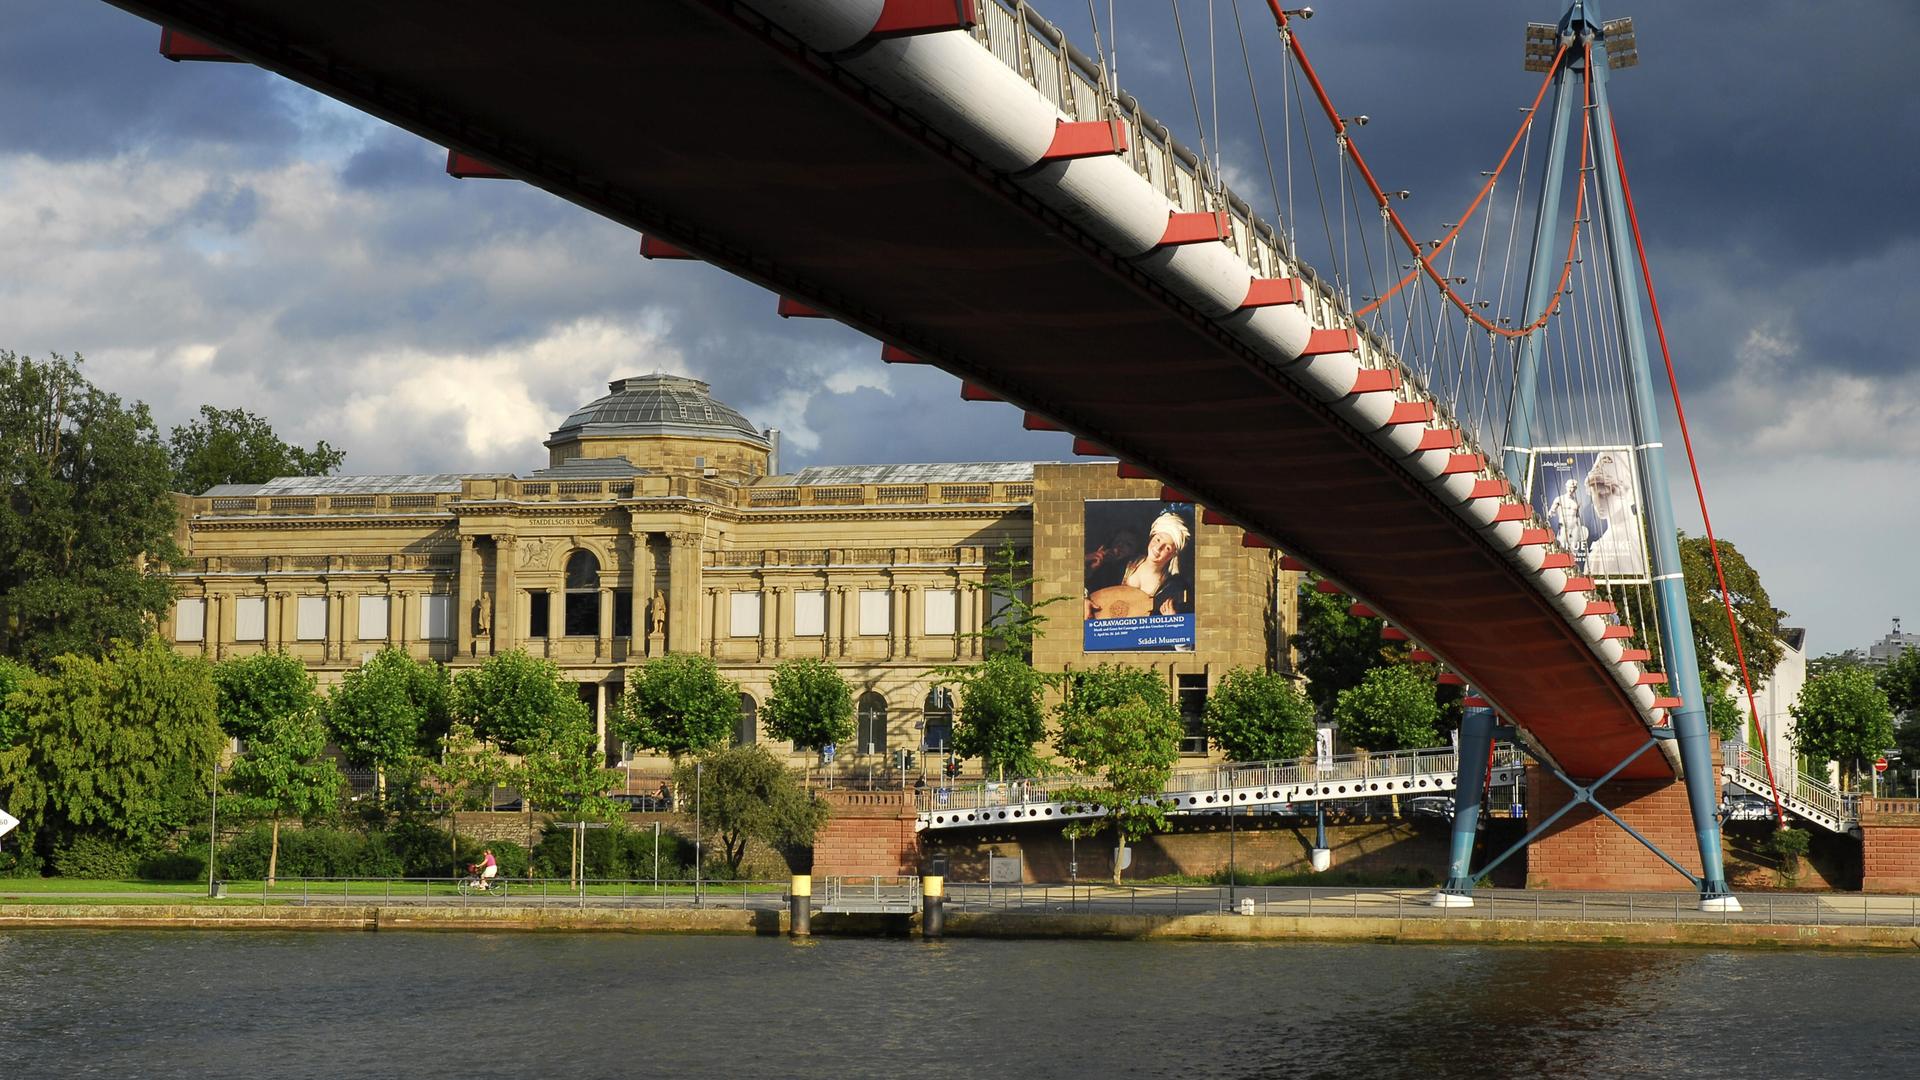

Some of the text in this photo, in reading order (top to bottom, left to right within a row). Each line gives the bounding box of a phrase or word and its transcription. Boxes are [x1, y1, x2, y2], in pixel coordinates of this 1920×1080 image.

[1093, 618, 1138, 628] CARAVAGGIO
[1139, 617, 1148, 625] IN
[1150, 615, 1185, 624] HOLLAND
[1137, 636, 1186, 646] Städel Museum
